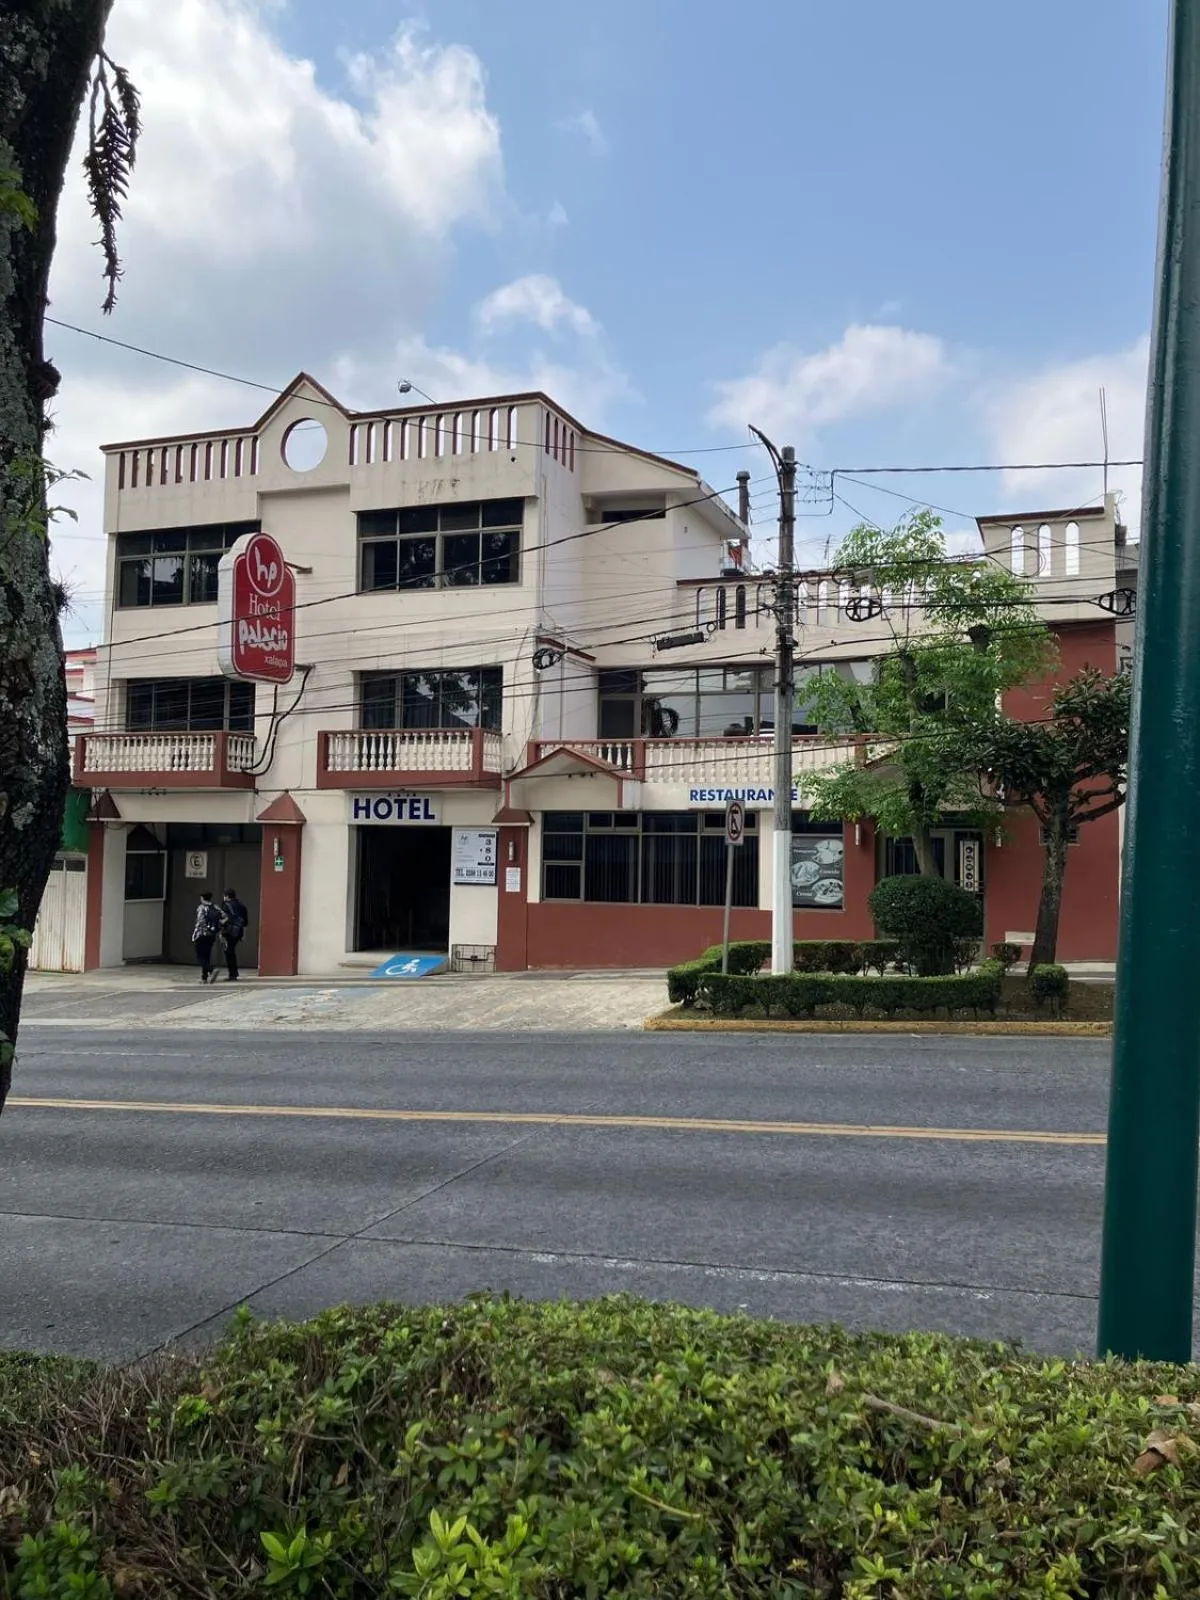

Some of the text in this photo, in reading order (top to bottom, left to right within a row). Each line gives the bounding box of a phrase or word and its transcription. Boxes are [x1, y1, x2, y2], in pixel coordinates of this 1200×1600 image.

[254, 546, 278, 589] hp
[249, 593, 281, 621] Hotel
[689, 788, 798, 802] RESTAURANE
[353, 798, 435, 820] HOTEL
